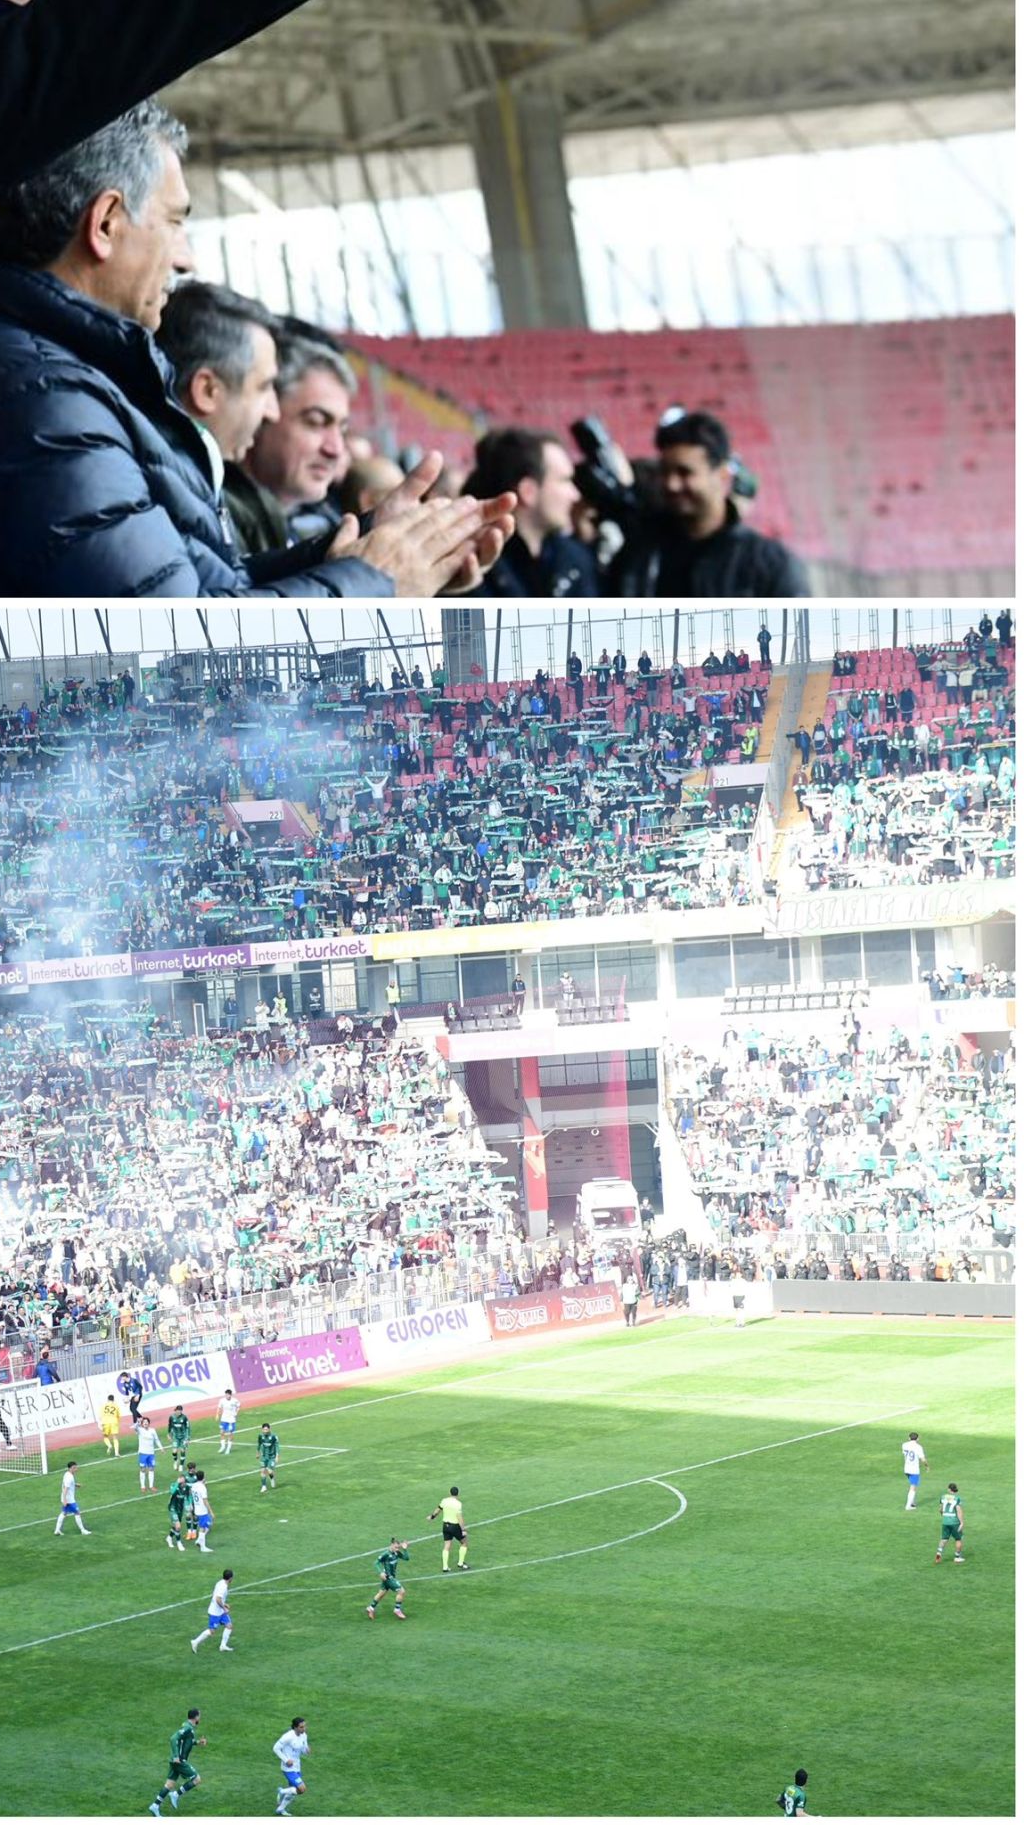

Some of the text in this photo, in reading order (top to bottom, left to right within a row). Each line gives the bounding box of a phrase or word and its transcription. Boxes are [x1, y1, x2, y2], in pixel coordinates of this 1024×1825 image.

[182, 949, 247, 969] turknet
[304, 940, 367, 960] turknet
[74, 957, 129, 978] turknet
[387, 1308, 469, 1344] EUROPEN
[262, 1349, 340, 1385] turknet
[104, 1404, 116, 1415] 52
[904, 1449, 916, 1462] 79
[941, 1498, 957, 1512] 77
